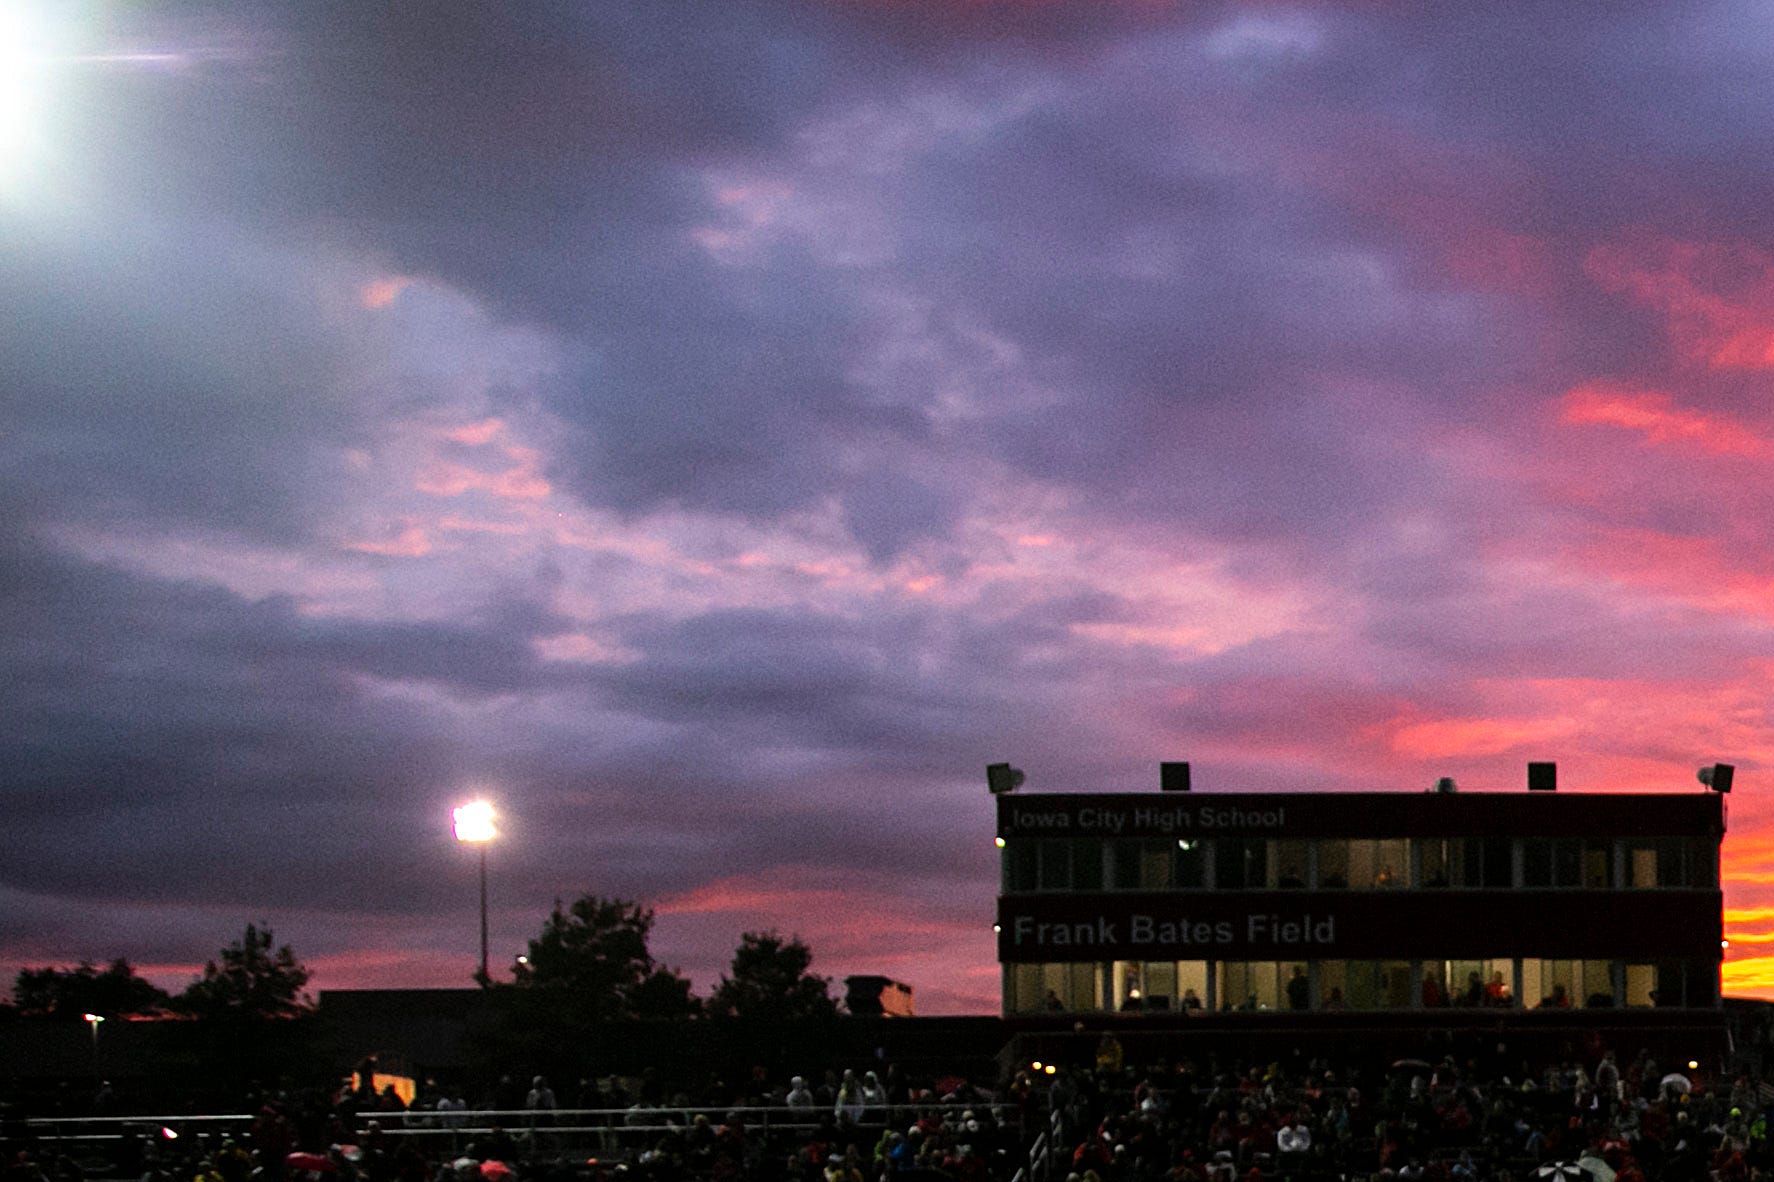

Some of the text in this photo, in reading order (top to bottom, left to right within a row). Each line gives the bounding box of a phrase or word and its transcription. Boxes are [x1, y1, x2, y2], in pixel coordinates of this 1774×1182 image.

[1013, 807, 1285, 832] Iowa City High School
[1014, 914, 1337, 945] Frank Bates Field
